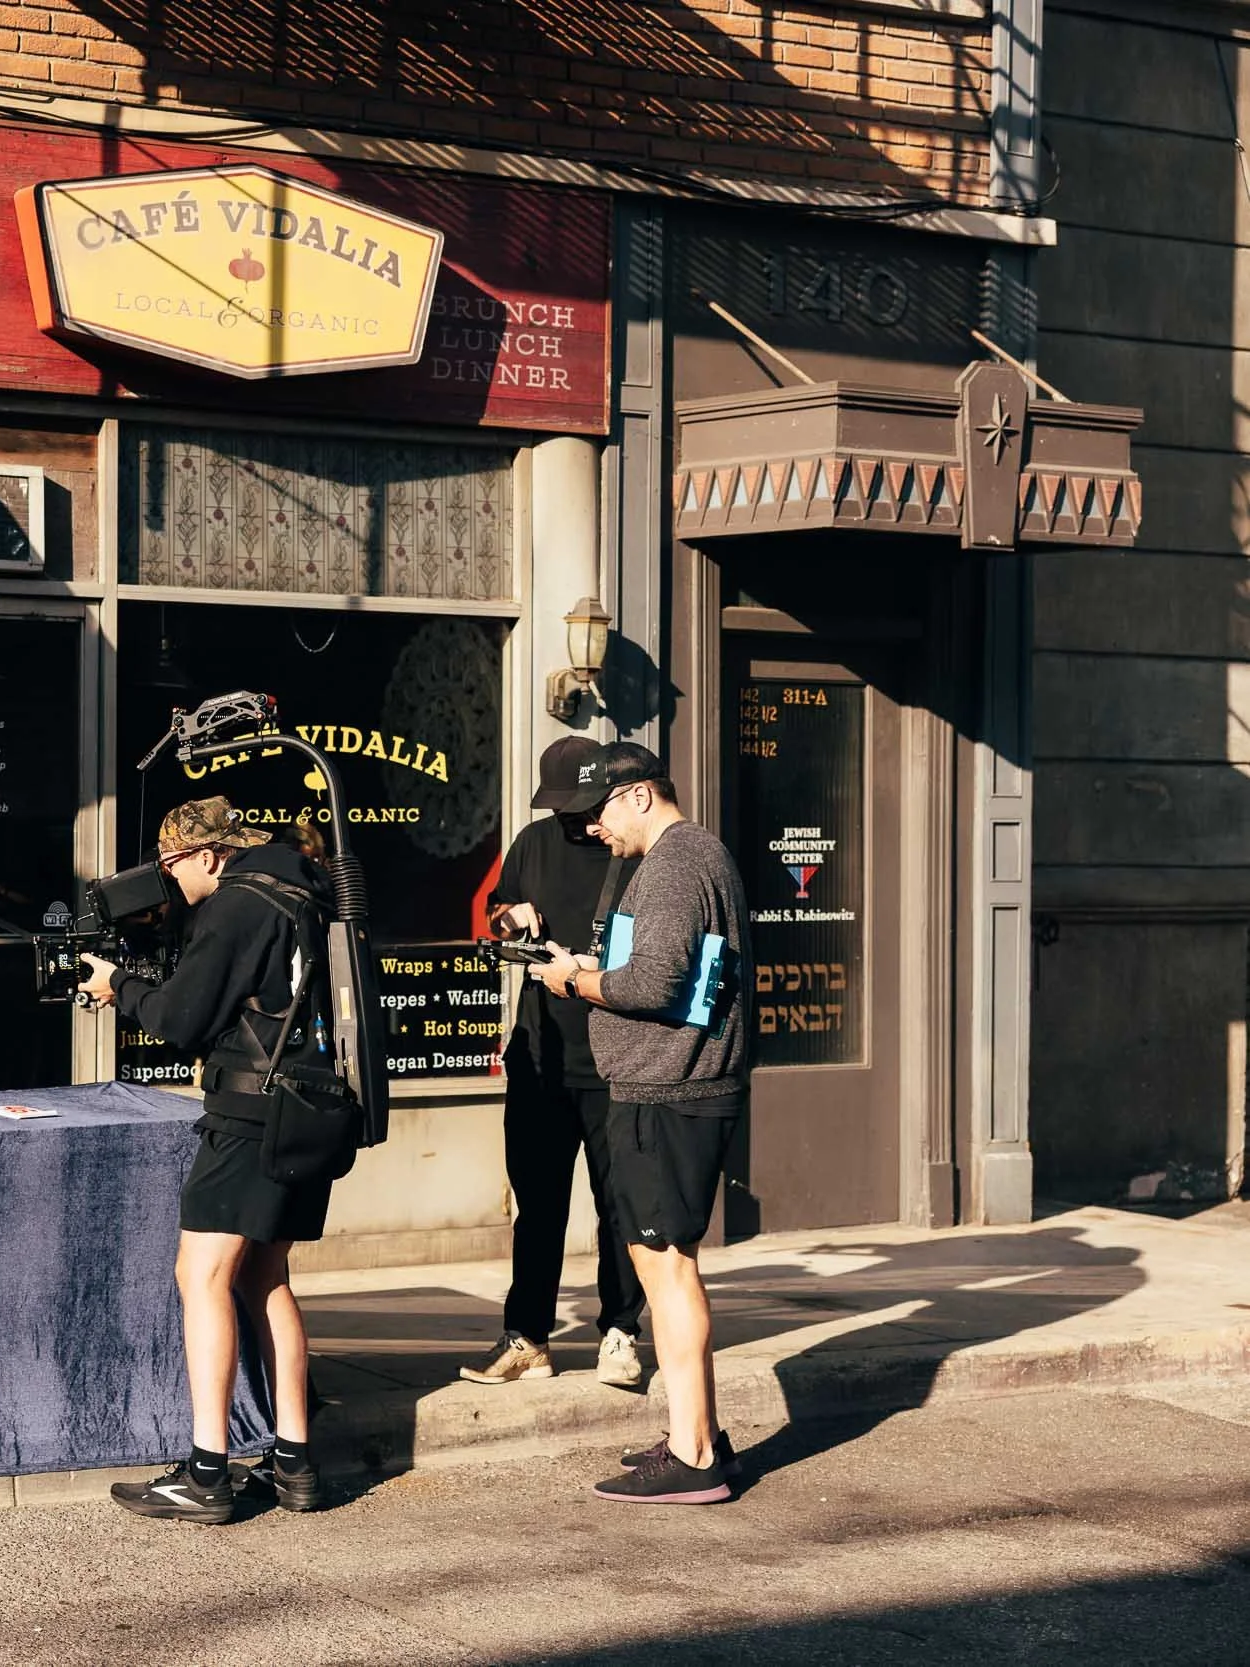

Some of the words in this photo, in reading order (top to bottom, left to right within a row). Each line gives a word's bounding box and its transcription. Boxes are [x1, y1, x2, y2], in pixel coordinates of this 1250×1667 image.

[77, 191, 199, 249] CAFÉ
[217, 200, 401, 288] VIDALIA
[762, 249, 908, 326] 140
[116, 293, 213, 318] LOCAL
[217, 297, 244, 328] &
[250, 306, 379, 335] ORGANIC
[431, 294, 574, 328] BRUNCH
[440, 327, 562, 358] LUNCH
[430, 357, 571, 390] DINNER
[296, 725, 449, 783] VIDALIA
[233, 808, 292, 823] OCAL
[296, 806, 313, 826] &
[317, 807, 420, 823] OGANIC
[782, 828, 821, 841] JEWISH
[769, 840, 836, 852] COMMUNITY
[782, 853, 824, 864] CENTER
[750, 910, 782, 922] Rabbi
[783, 910, 794, 922] S.
[795, 908, 855, 922] Rabinowitz
[380, 958, 433, 976] Wraps
[756, 963, 847, 992] ברוכים
[379, 994, 427, 1010] repes
[446, 989, 508, 1006] Waffles
[424, 1021, 453, 1037] Hot
[457, 1020, 506, 1038] Soups
[759, 1003, 843, 1034] הבאים
[121, 1062, 205, 1083] Superfoo
[386, 1057, 428, 1072] egan
[432, 1053, 504, 1069] Desserts
